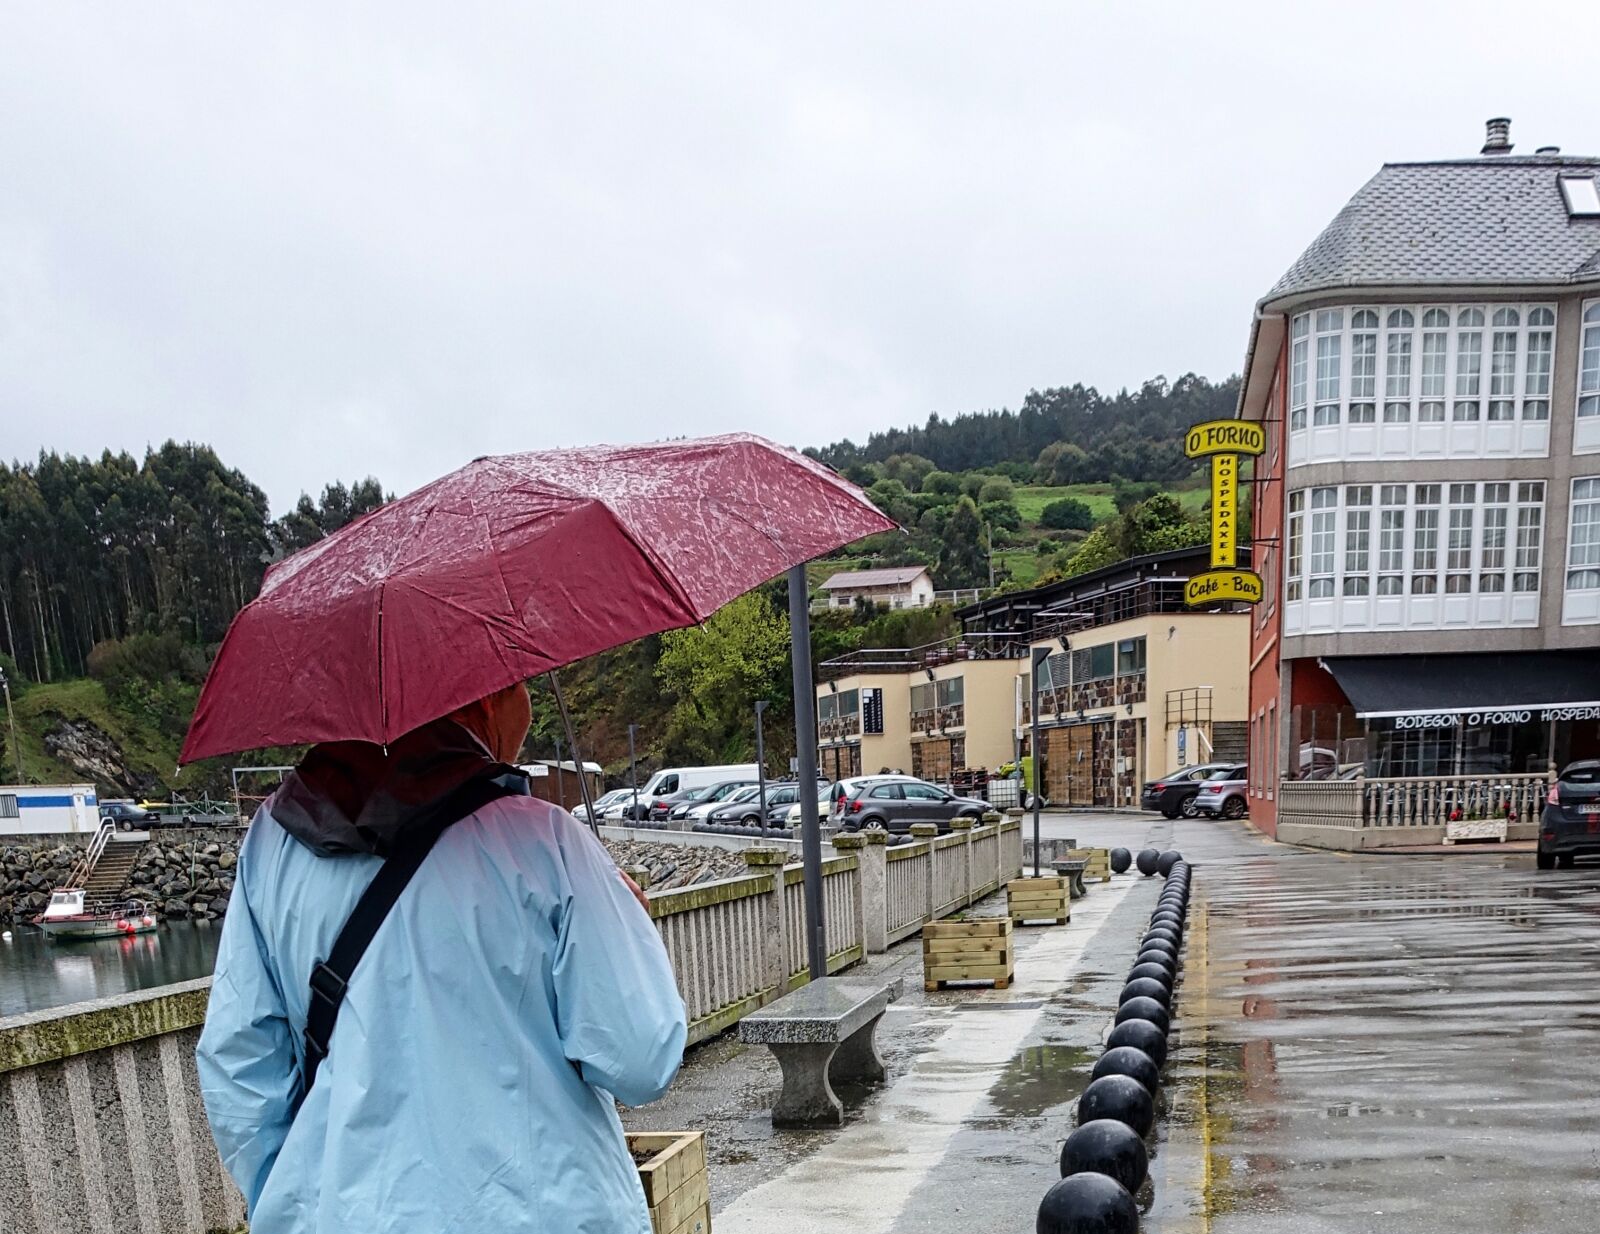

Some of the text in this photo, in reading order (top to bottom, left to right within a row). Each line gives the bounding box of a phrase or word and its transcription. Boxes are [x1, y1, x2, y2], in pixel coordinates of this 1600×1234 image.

[1219, 458, 1231, 549] HOSPEDAXE
[1189, 578, 1219, 598] Café
[1232, 576, 1259, 595] Bar
[1395, 714, 1461, 729] BODEGON
[1467, 713, 1481, 726] O
[1483, 710, 1532, 725] FORNO
